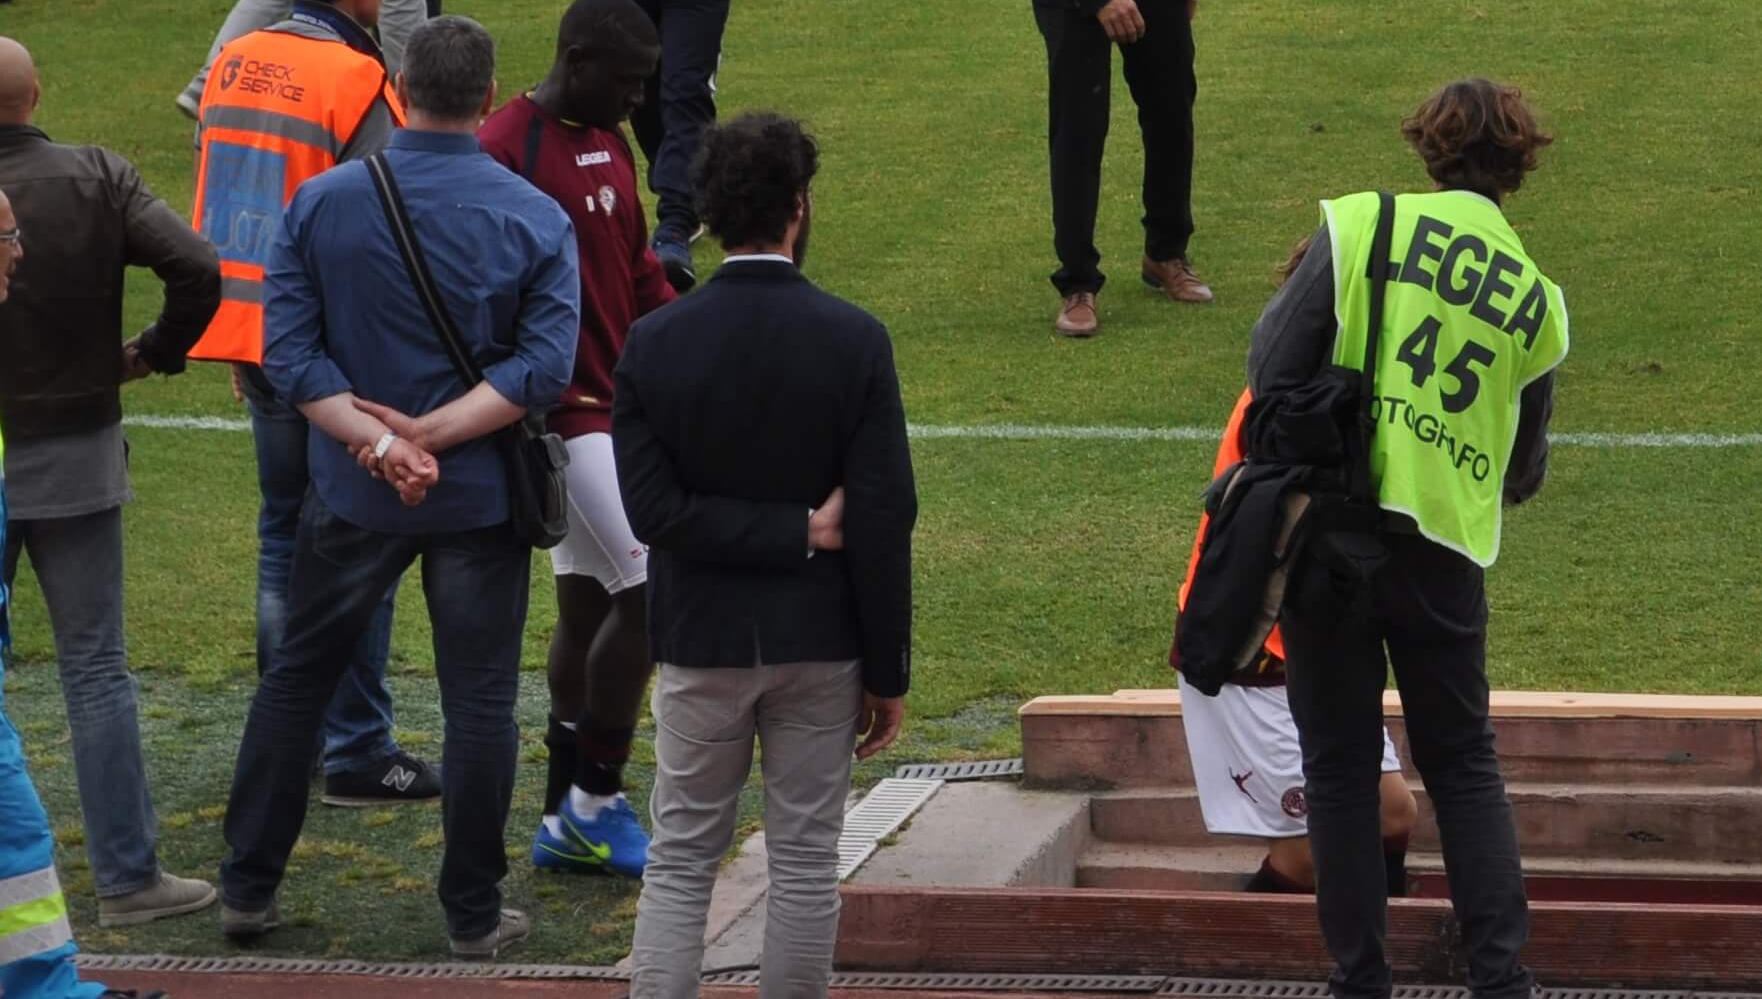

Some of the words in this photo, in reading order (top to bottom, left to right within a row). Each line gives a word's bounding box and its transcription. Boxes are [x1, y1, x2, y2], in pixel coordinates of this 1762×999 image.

[244, 60, 296, 82] CHECK
[238, 76, 305, 102] SERVICE
[1396, 314, 1496, 414] 45
